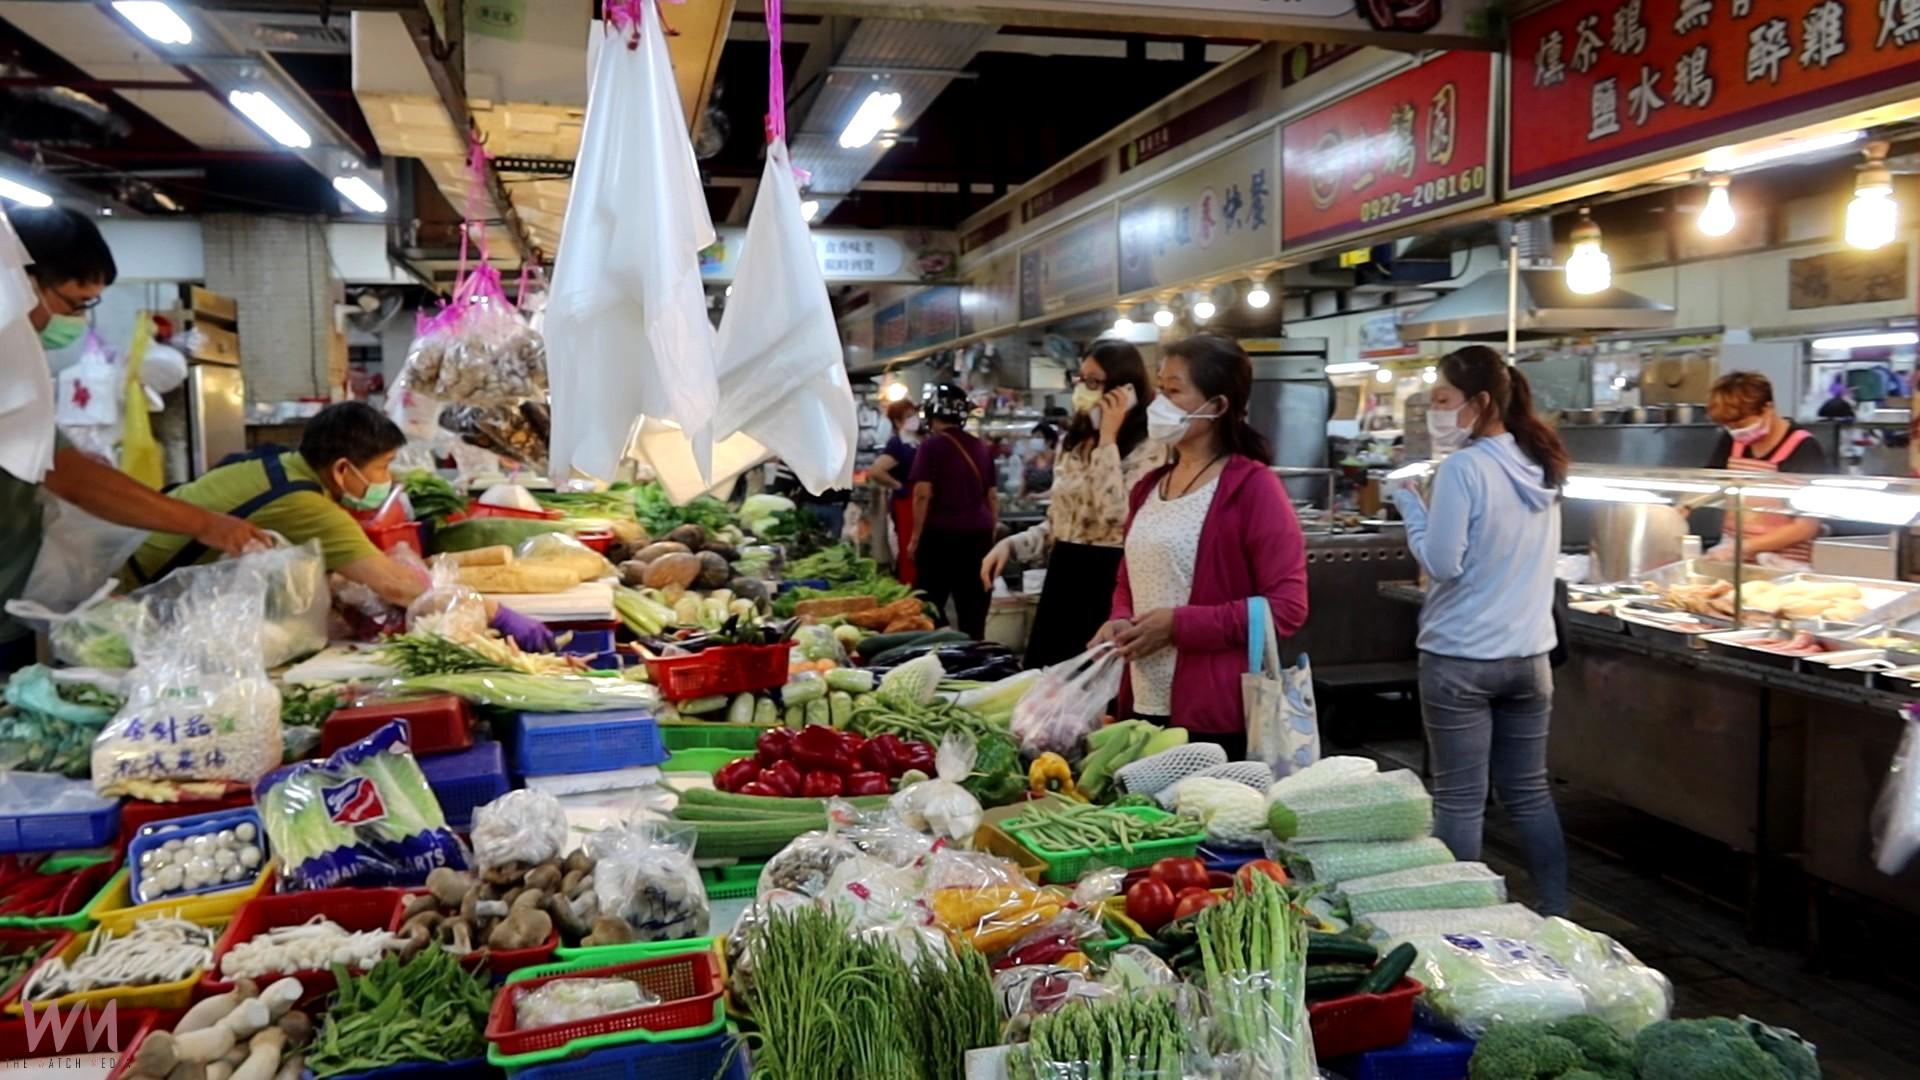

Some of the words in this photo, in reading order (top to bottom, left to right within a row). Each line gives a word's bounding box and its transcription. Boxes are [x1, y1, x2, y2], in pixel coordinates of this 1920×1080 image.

[1587, 47, 1714, 140] 鹽水鵝
[1747, 2, 1846, 83] 醉雞
[1360, 166, 1485, 222] 0922-208160
